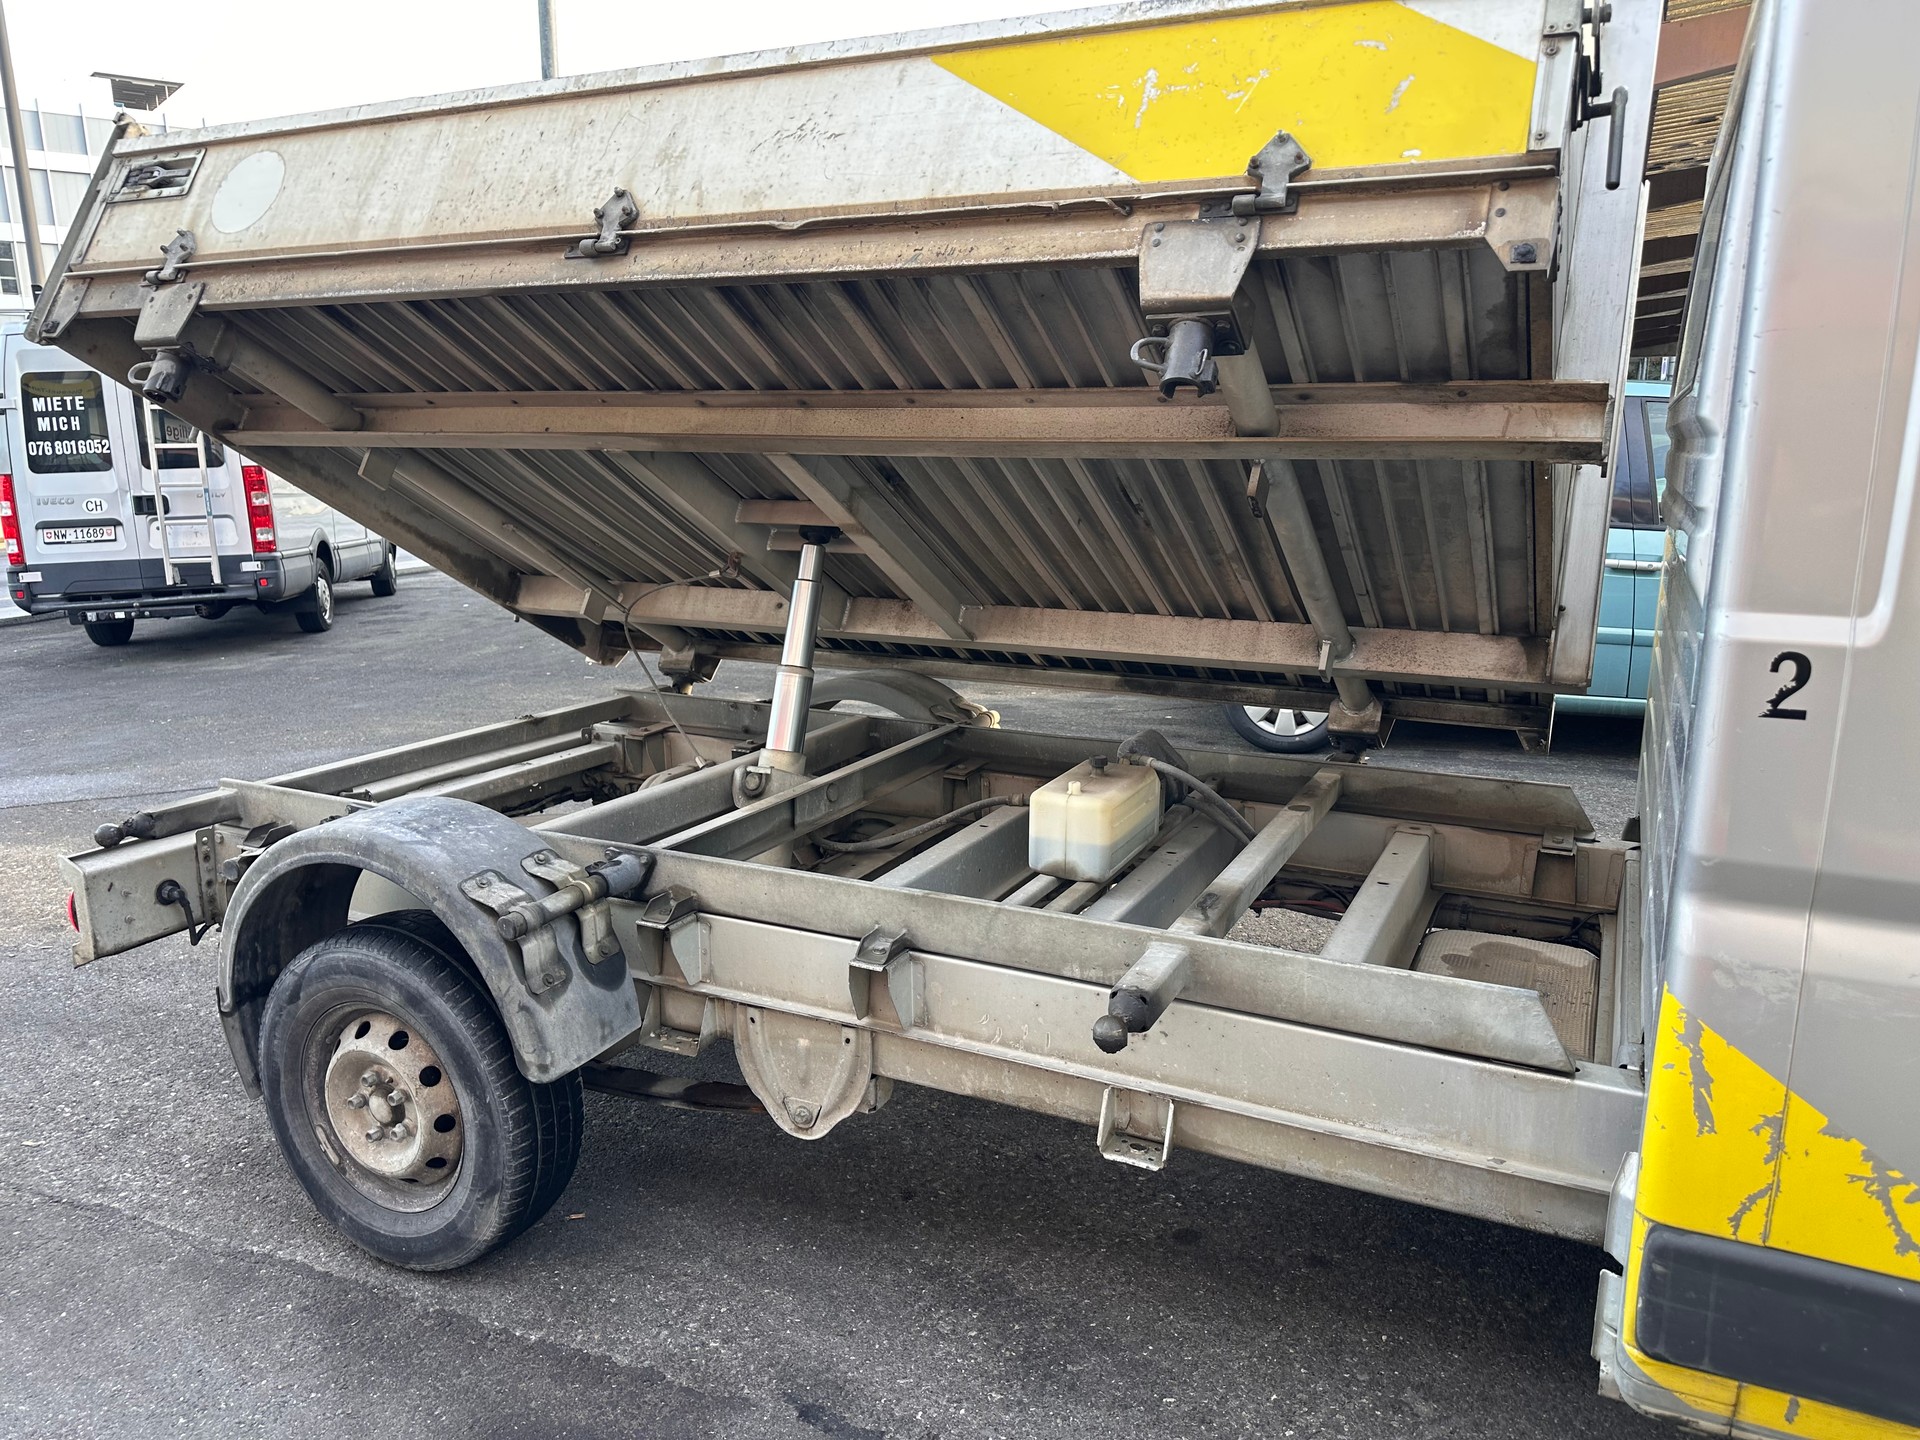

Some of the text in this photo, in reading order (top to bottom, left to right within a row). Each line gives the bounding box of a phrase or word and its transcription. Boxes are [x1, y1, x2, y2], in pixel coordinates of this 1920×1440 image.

[32, 395, 85, 412] MIETE
[37, 416, 81, 432] MICH
[28, 440, 53, 456] 076
[36, 497, 75, 506] IVECO
[85, 500, 103, 512] CH
[1758, 651, 1812, 720] 2
